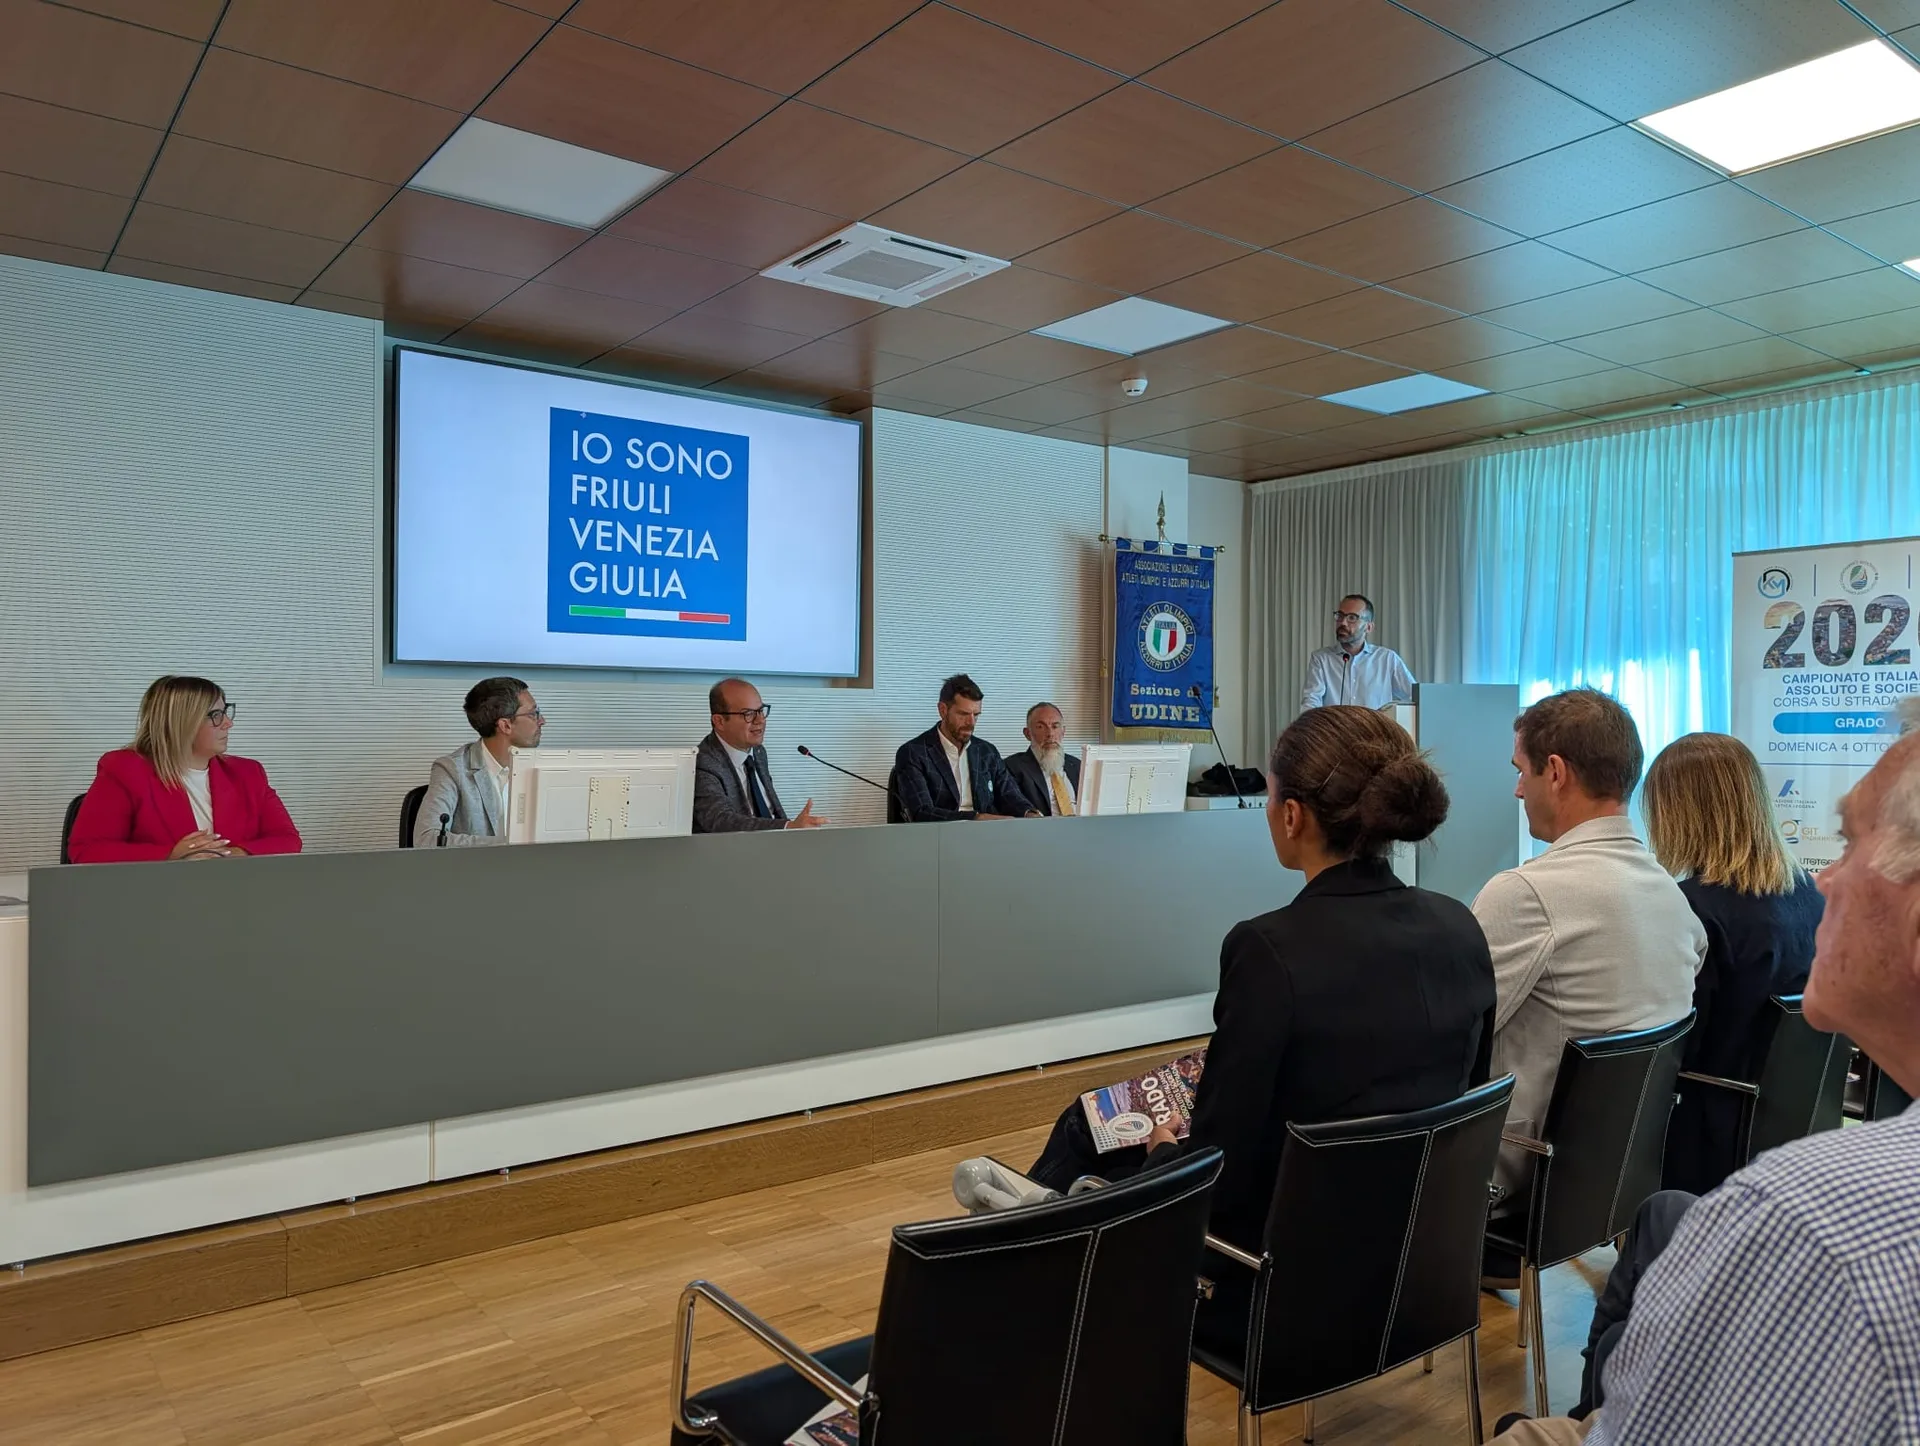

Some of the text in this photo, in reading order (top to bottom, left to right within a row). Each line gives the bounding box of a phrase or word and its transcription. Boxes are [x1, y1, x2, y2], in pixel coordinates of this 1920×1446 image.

[571, 430, 733, 480] IO SONO
[571, 474, 671, 515] FRIULI
[568, 517, 720, 561] VENEZIA
[1135, 560, 1199, 575] ASSOCIAZIONE NAZIONALE
[569, 561, 688, 600] GIULIA
[1122, 573, 1138, 584] ATLETI
[1140, 575, 1160, 587] OLIMPICI
[1162, 577, 1167, 587] E
[1167, 578, 1189, 589] AZZURRI
[1140, 604, 1194, 635] ATLETI OLIMPICI
[1155, 620, 1177, 629] ITALIA
[1763, 594, 1920, 669] 202
[1140, 641, 1163, 670] AZZURRI
[1782, 671, 1920, 684] CAMPIONATO ITALIA
[1130, 683, 1180, 697] Sezione
[1785, 683, 1920, 696] ASSOLUTO E SOCIE
[1773, 695, 1898, 707] CORSA SU STRADA
[1129, 703, 1200, 723] UDINE
[1834, 717, 1886, 729] GRADO
[1768, 741, 1889, 752] DOMENICA 4 OTTO
[1141, 1076, 1172, 1126] RADO
